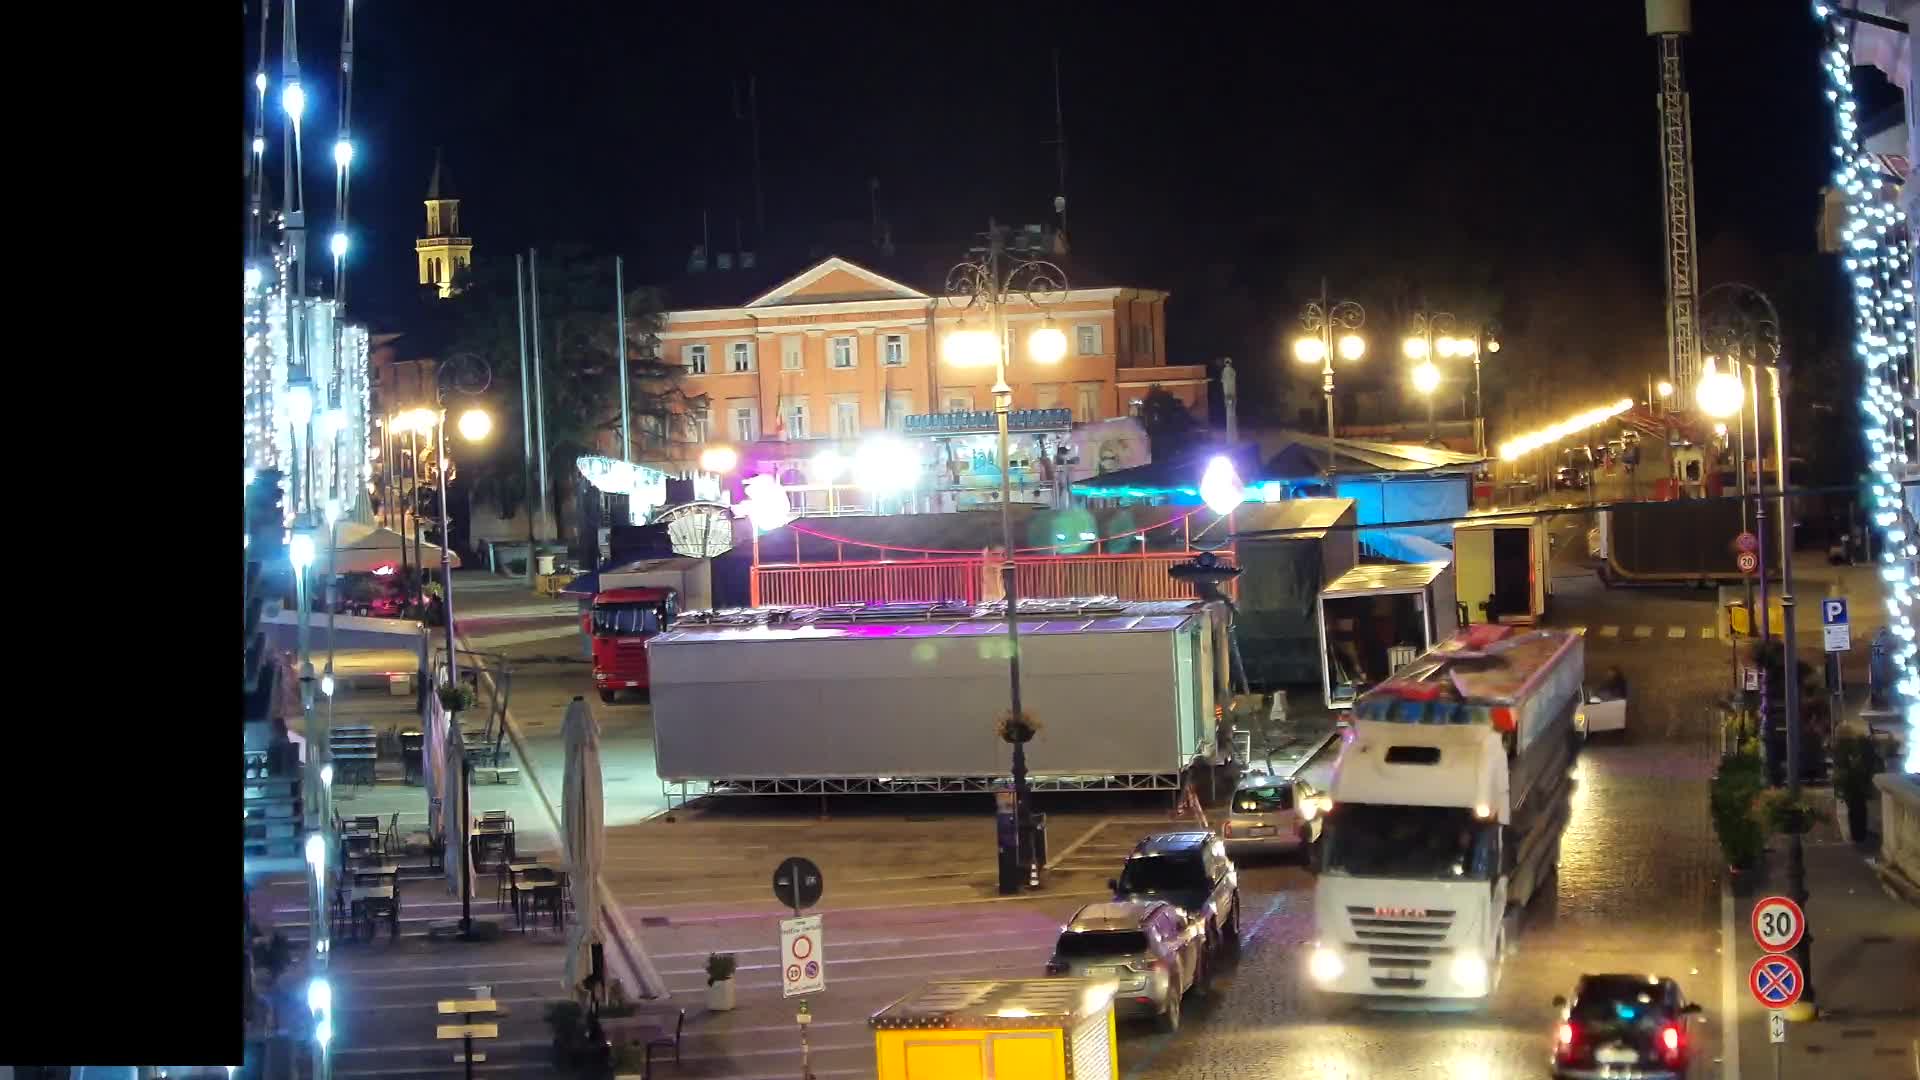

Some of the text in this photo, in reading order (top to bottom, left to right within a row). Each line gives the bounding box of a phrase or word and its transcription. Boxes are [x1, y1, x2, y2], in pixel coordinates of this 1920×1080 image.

[1742, 557, 1753, 567] 20
[1827, 602, 1843, 622] P
[1762, 912, 1791, 937] 30
